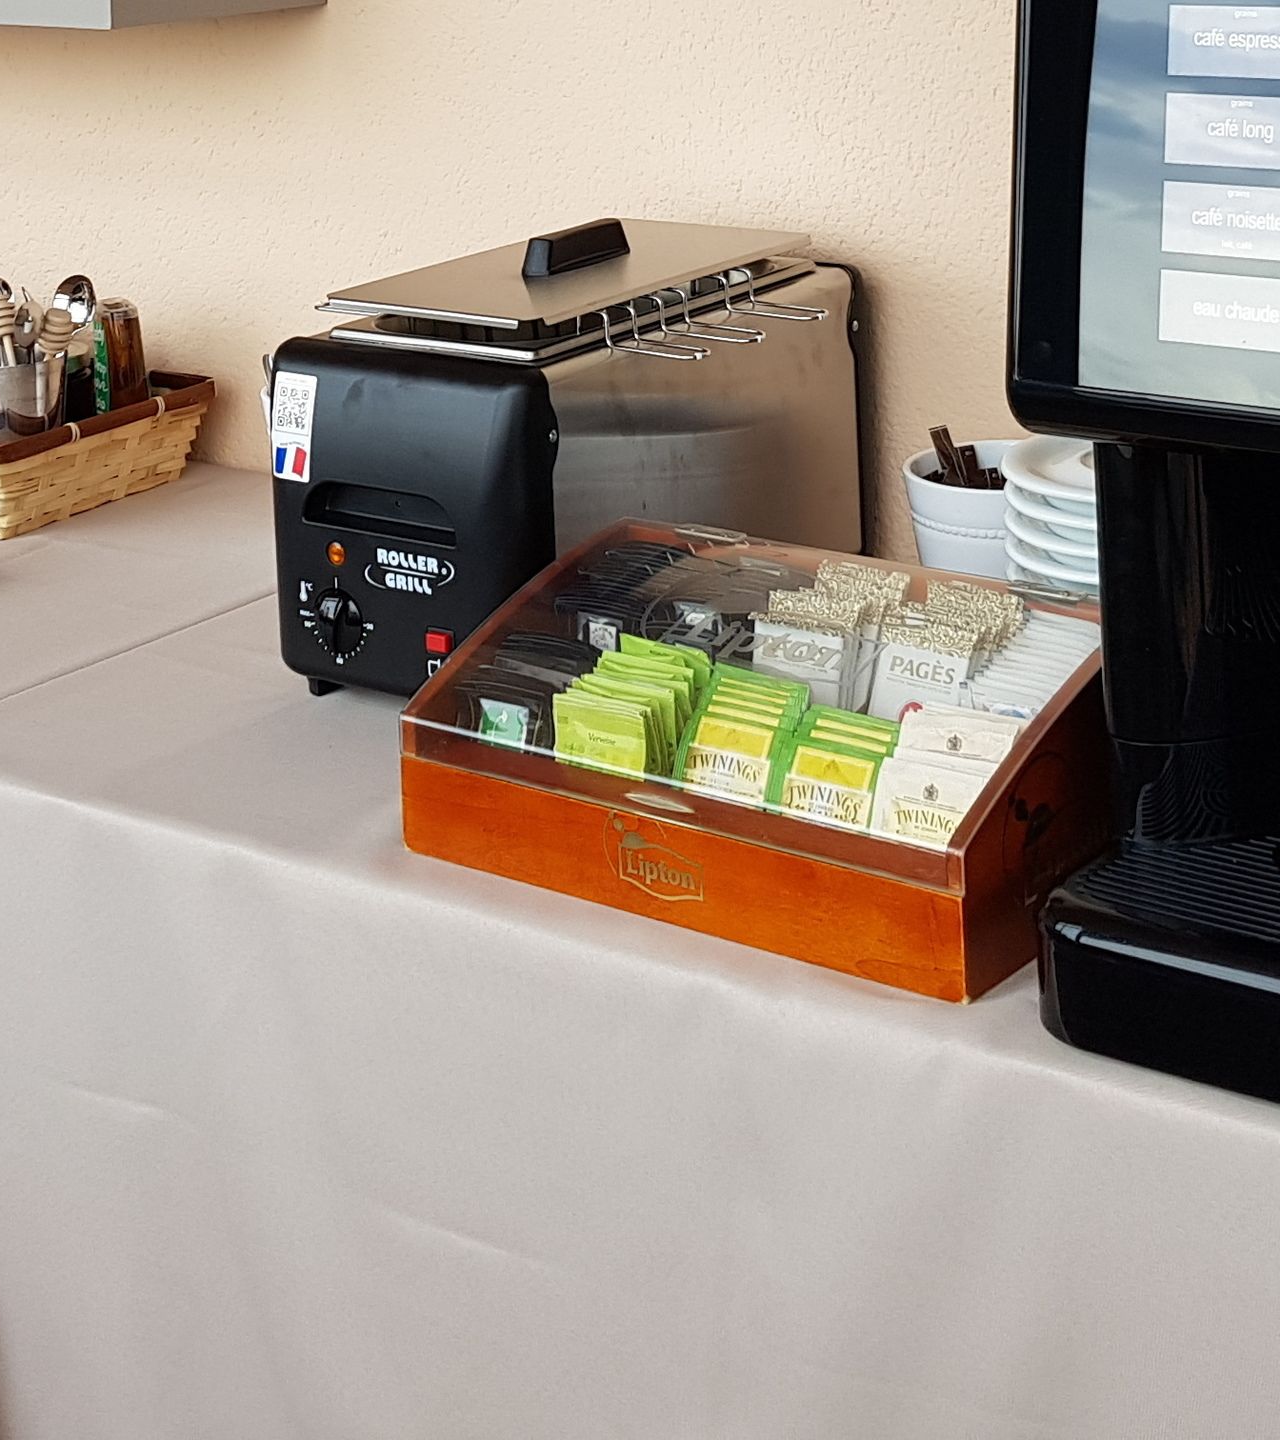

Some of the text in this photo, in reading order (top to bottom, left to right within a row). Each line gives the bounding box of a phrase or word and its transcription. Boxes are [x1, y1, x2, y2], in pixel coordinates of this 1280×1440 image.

[1193, 29, 1225, 47] café
[1207, 118, 1274, 144] café long
[1191, 207, 1224, 226] café
[1192, 301, 1280, 324] eau chaude
[376, 547, 439, 574] ROLLER
[384, 572, 433, 596] GRILL
[889, 654, 956, 686] PAGÈS
[690, 753, 761, 783] TWININGS
[787, 784, 863, 825] TWININGS
[894, 808, 957, 834] TWINING
[625, 848, 696, 890] Lipton
